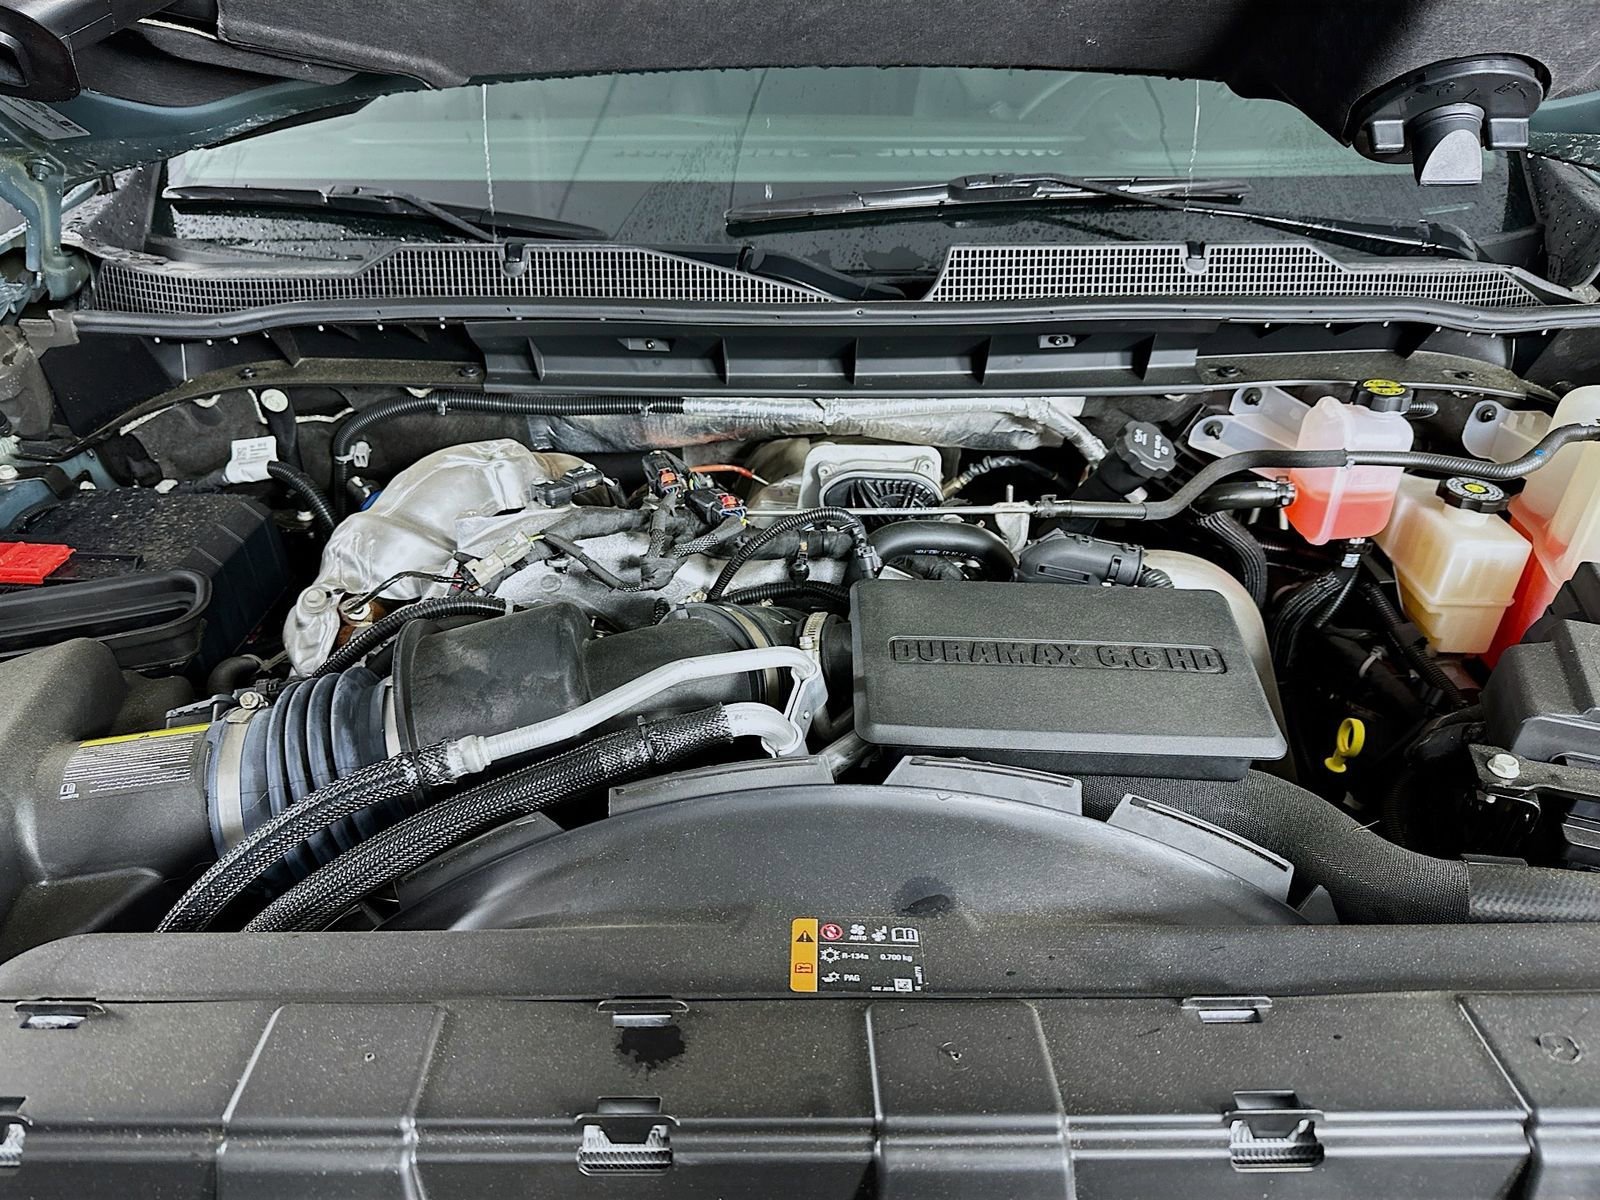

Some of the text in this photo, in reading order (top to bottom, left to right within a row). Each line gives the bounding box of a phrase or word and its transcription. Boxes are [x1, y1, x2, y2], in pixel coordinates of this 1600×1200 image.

[892, 640, 1081, 667] DURAMAX
[841, 952, 913, 963] R-134a 0.700 kg
[843, 974, 860, 982] PAG
